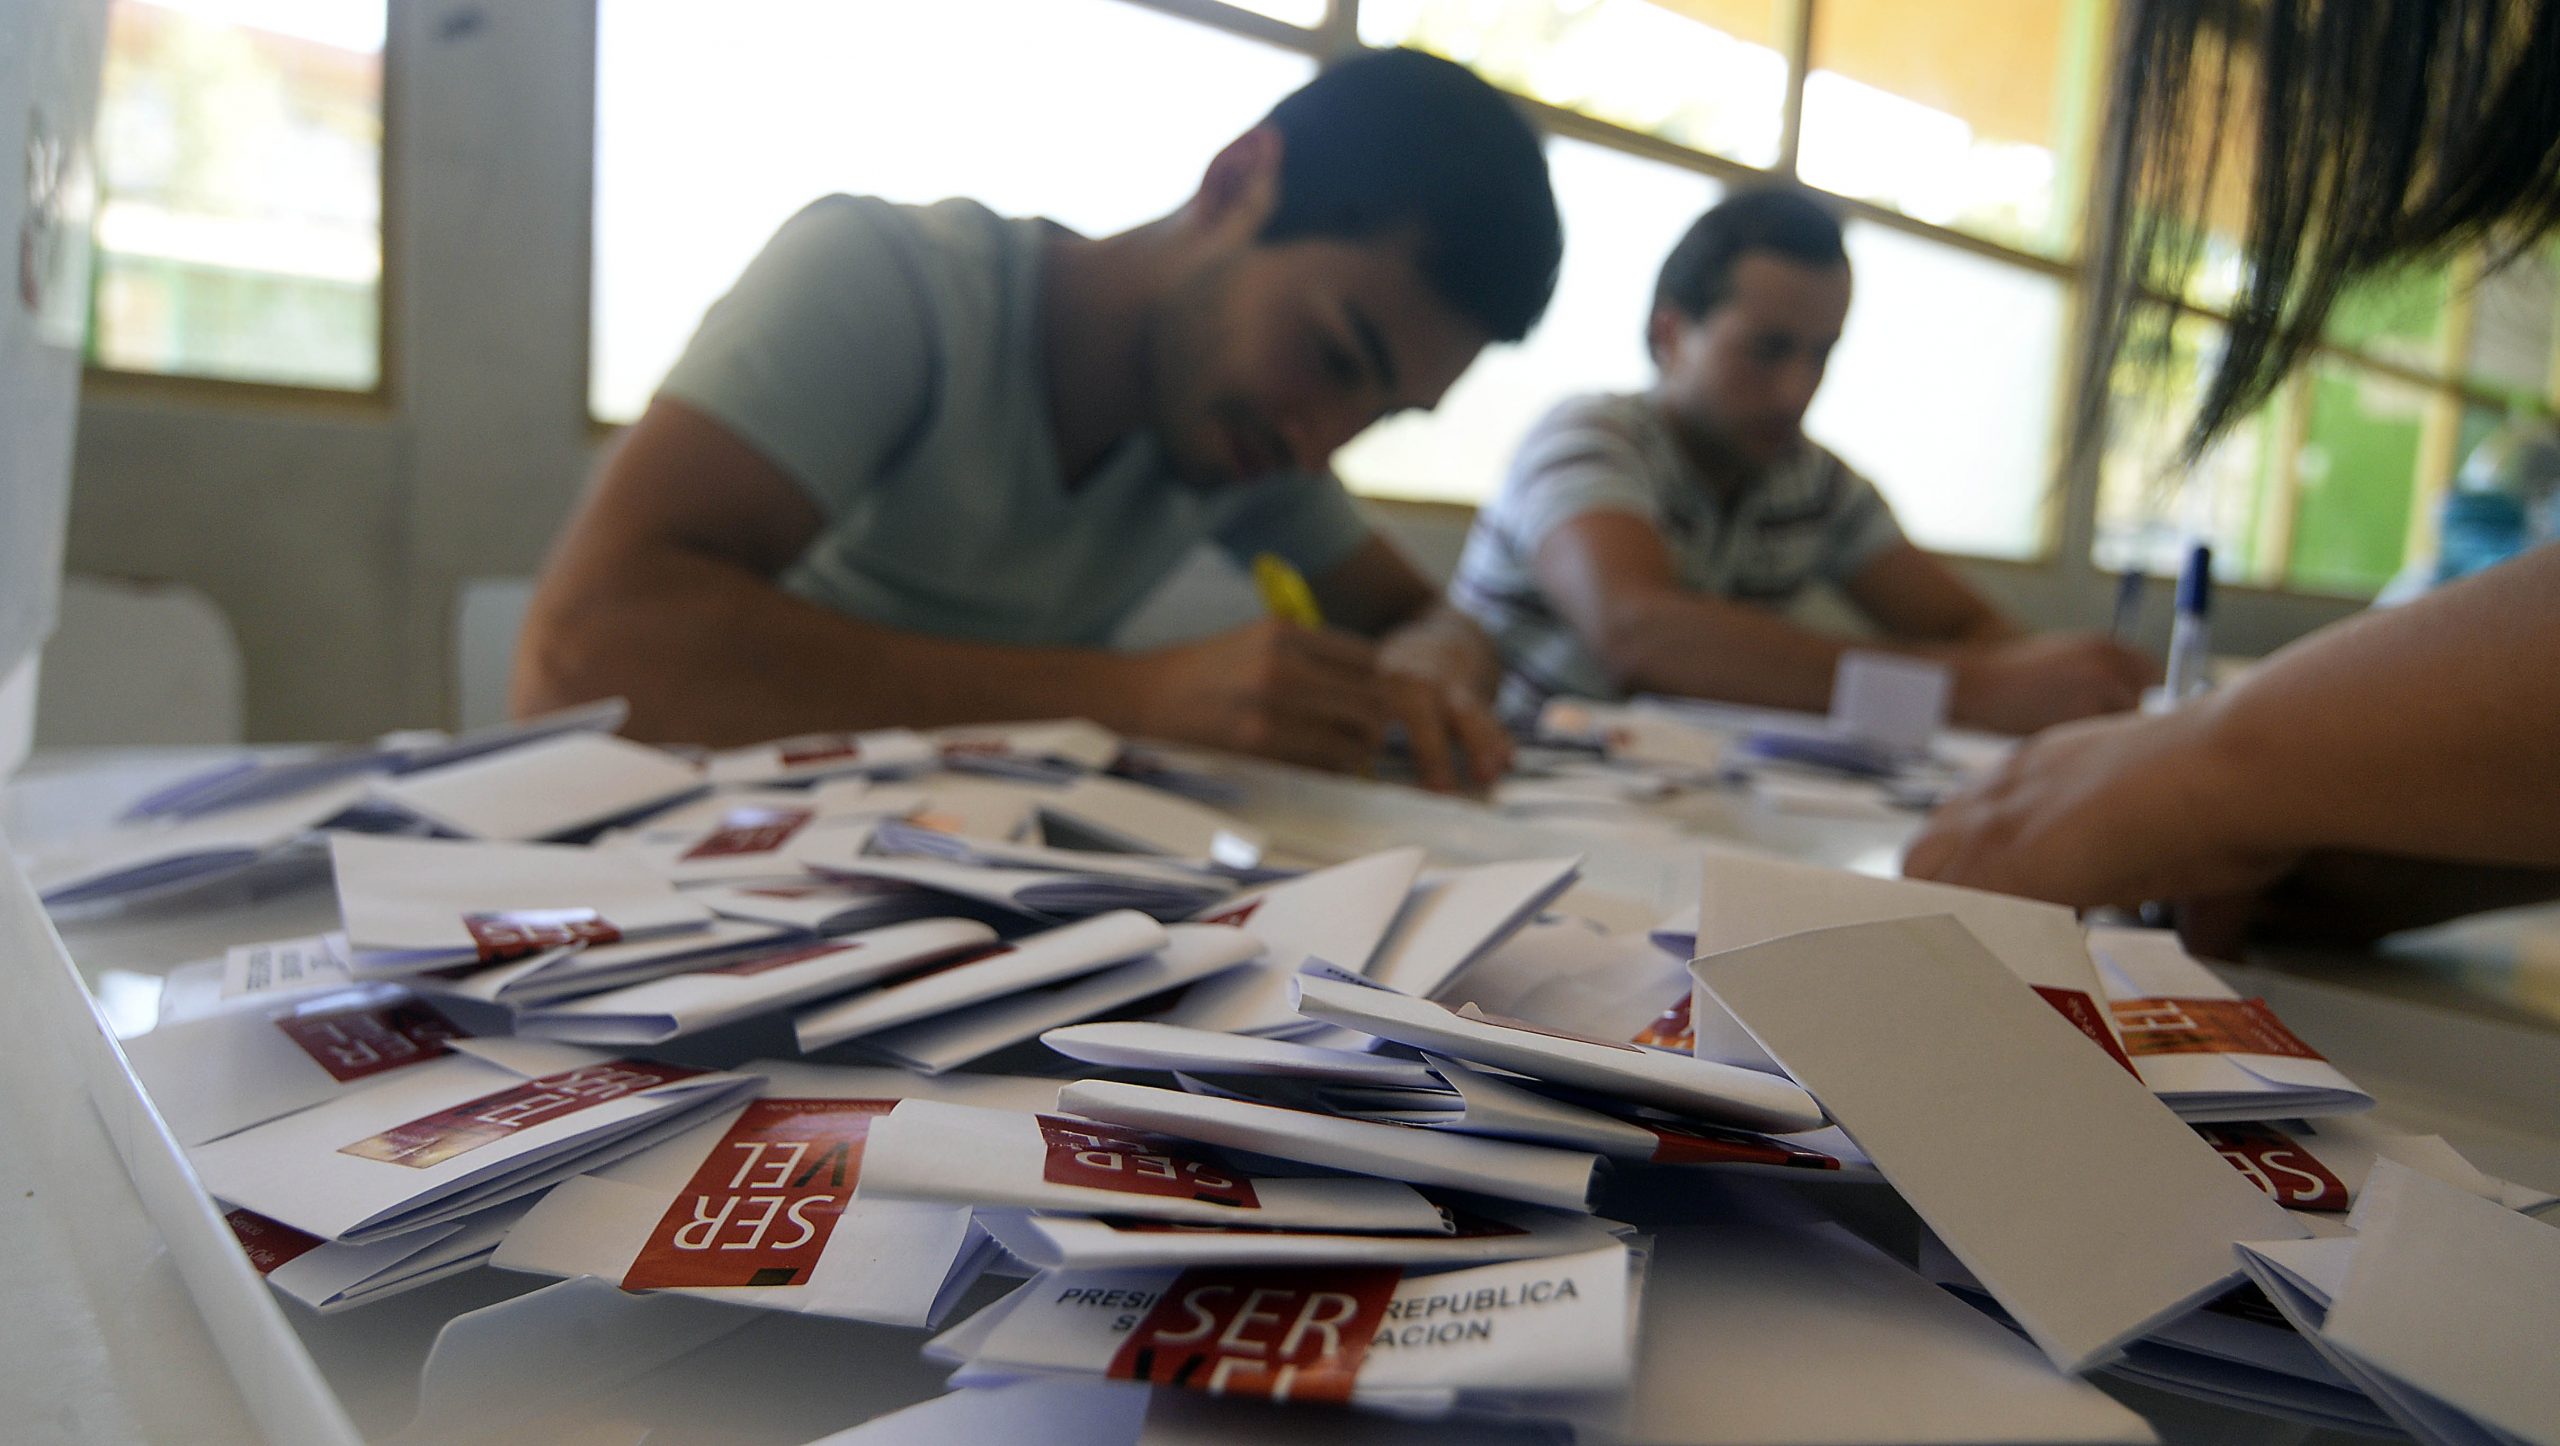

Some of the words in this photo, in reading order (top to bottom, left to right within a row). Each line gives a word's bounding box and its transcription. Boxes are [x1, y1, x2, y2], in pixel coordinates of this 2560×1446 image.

[728, 1141, 849, 1188] VEL
[2218, 1151, 2325, 1201] SE
[673, 1195, 836, 1250] SER
[1056, 1287, 1158, 1309] PRESI
[1153, 1285, 1358, 1360] SER
[1371, 1318, 1492, 1347] ACION
